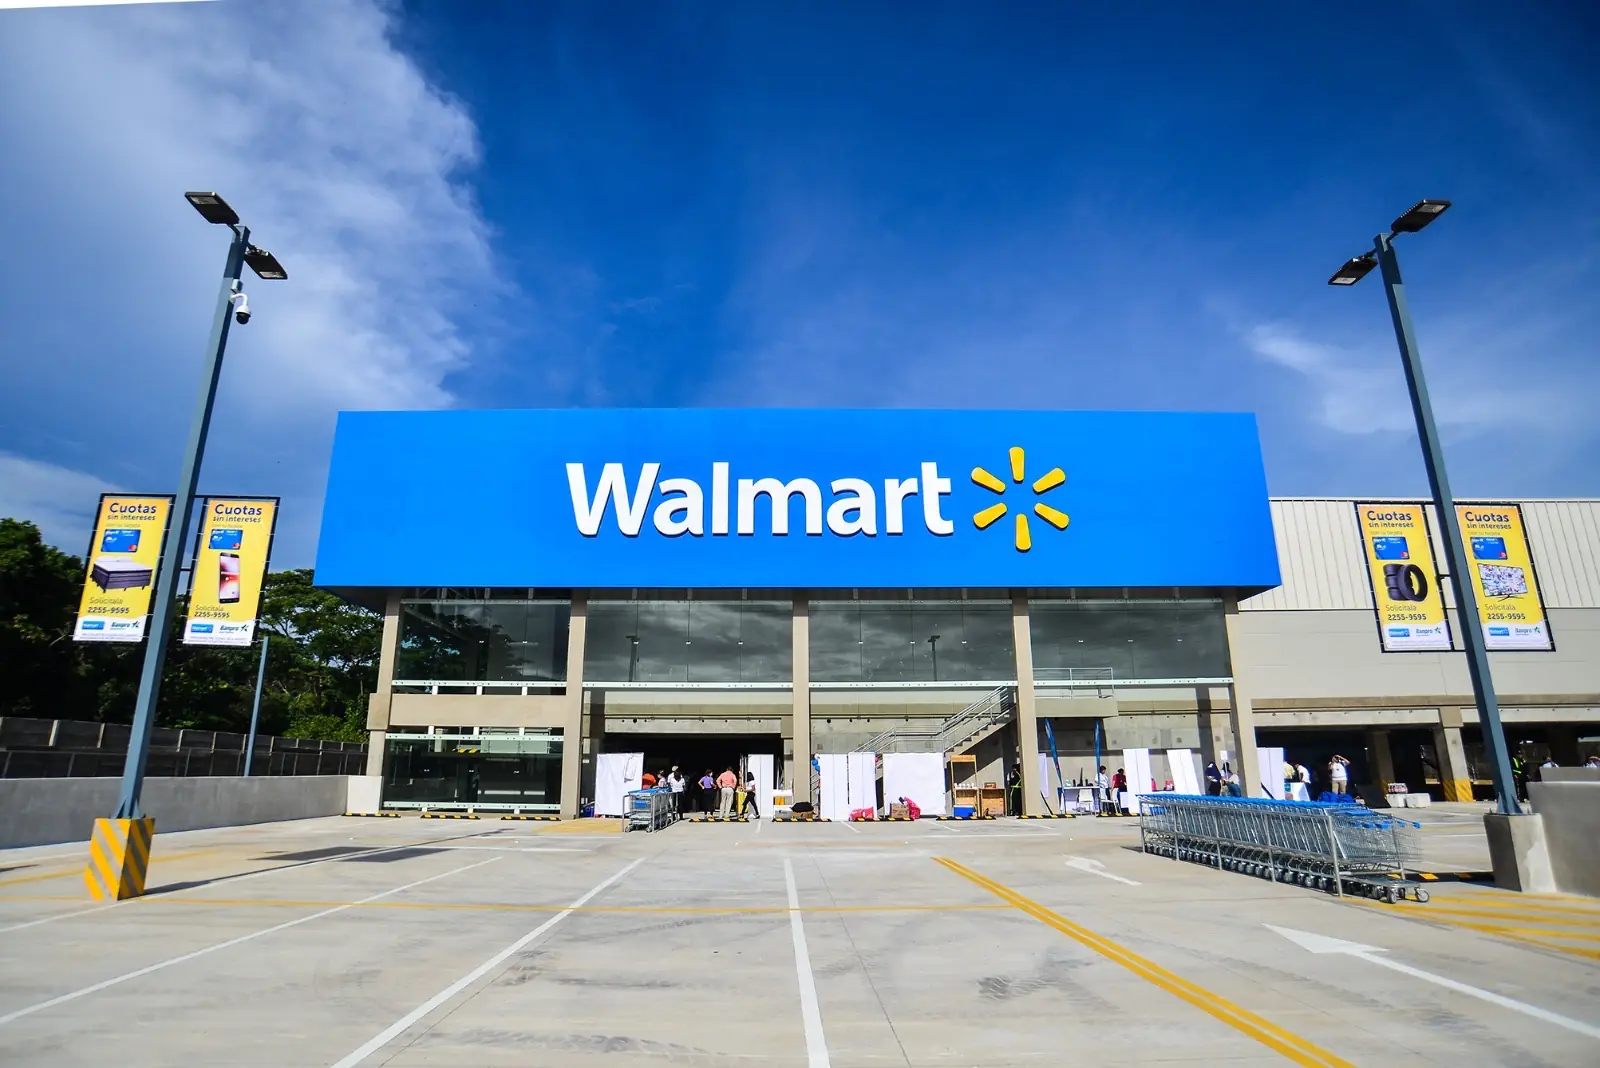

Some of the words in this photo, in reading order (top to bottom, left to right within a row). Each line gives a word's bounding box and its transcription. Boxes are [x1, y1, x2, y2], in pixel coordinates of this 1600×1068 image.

[565, 461, 954, 537] Walmart
[110, 502, 157, 514] Cuotas
[215, 503, 263, 516] Cuotas
[226, 515, 263, 523] intereses
[1367, 510, 1412, 521] Cuotas
[1465, 511, 1510, 523] Cuotas
[1479, 522, 1512, 530] intereses
[87, 606, 130, 614] 2255-9595
[194, 611, 230, 619] 2255-9595
[1387, 613, 1427, 621] 2255-9595
[1487, 612, 1526, 620] 2255-9595
